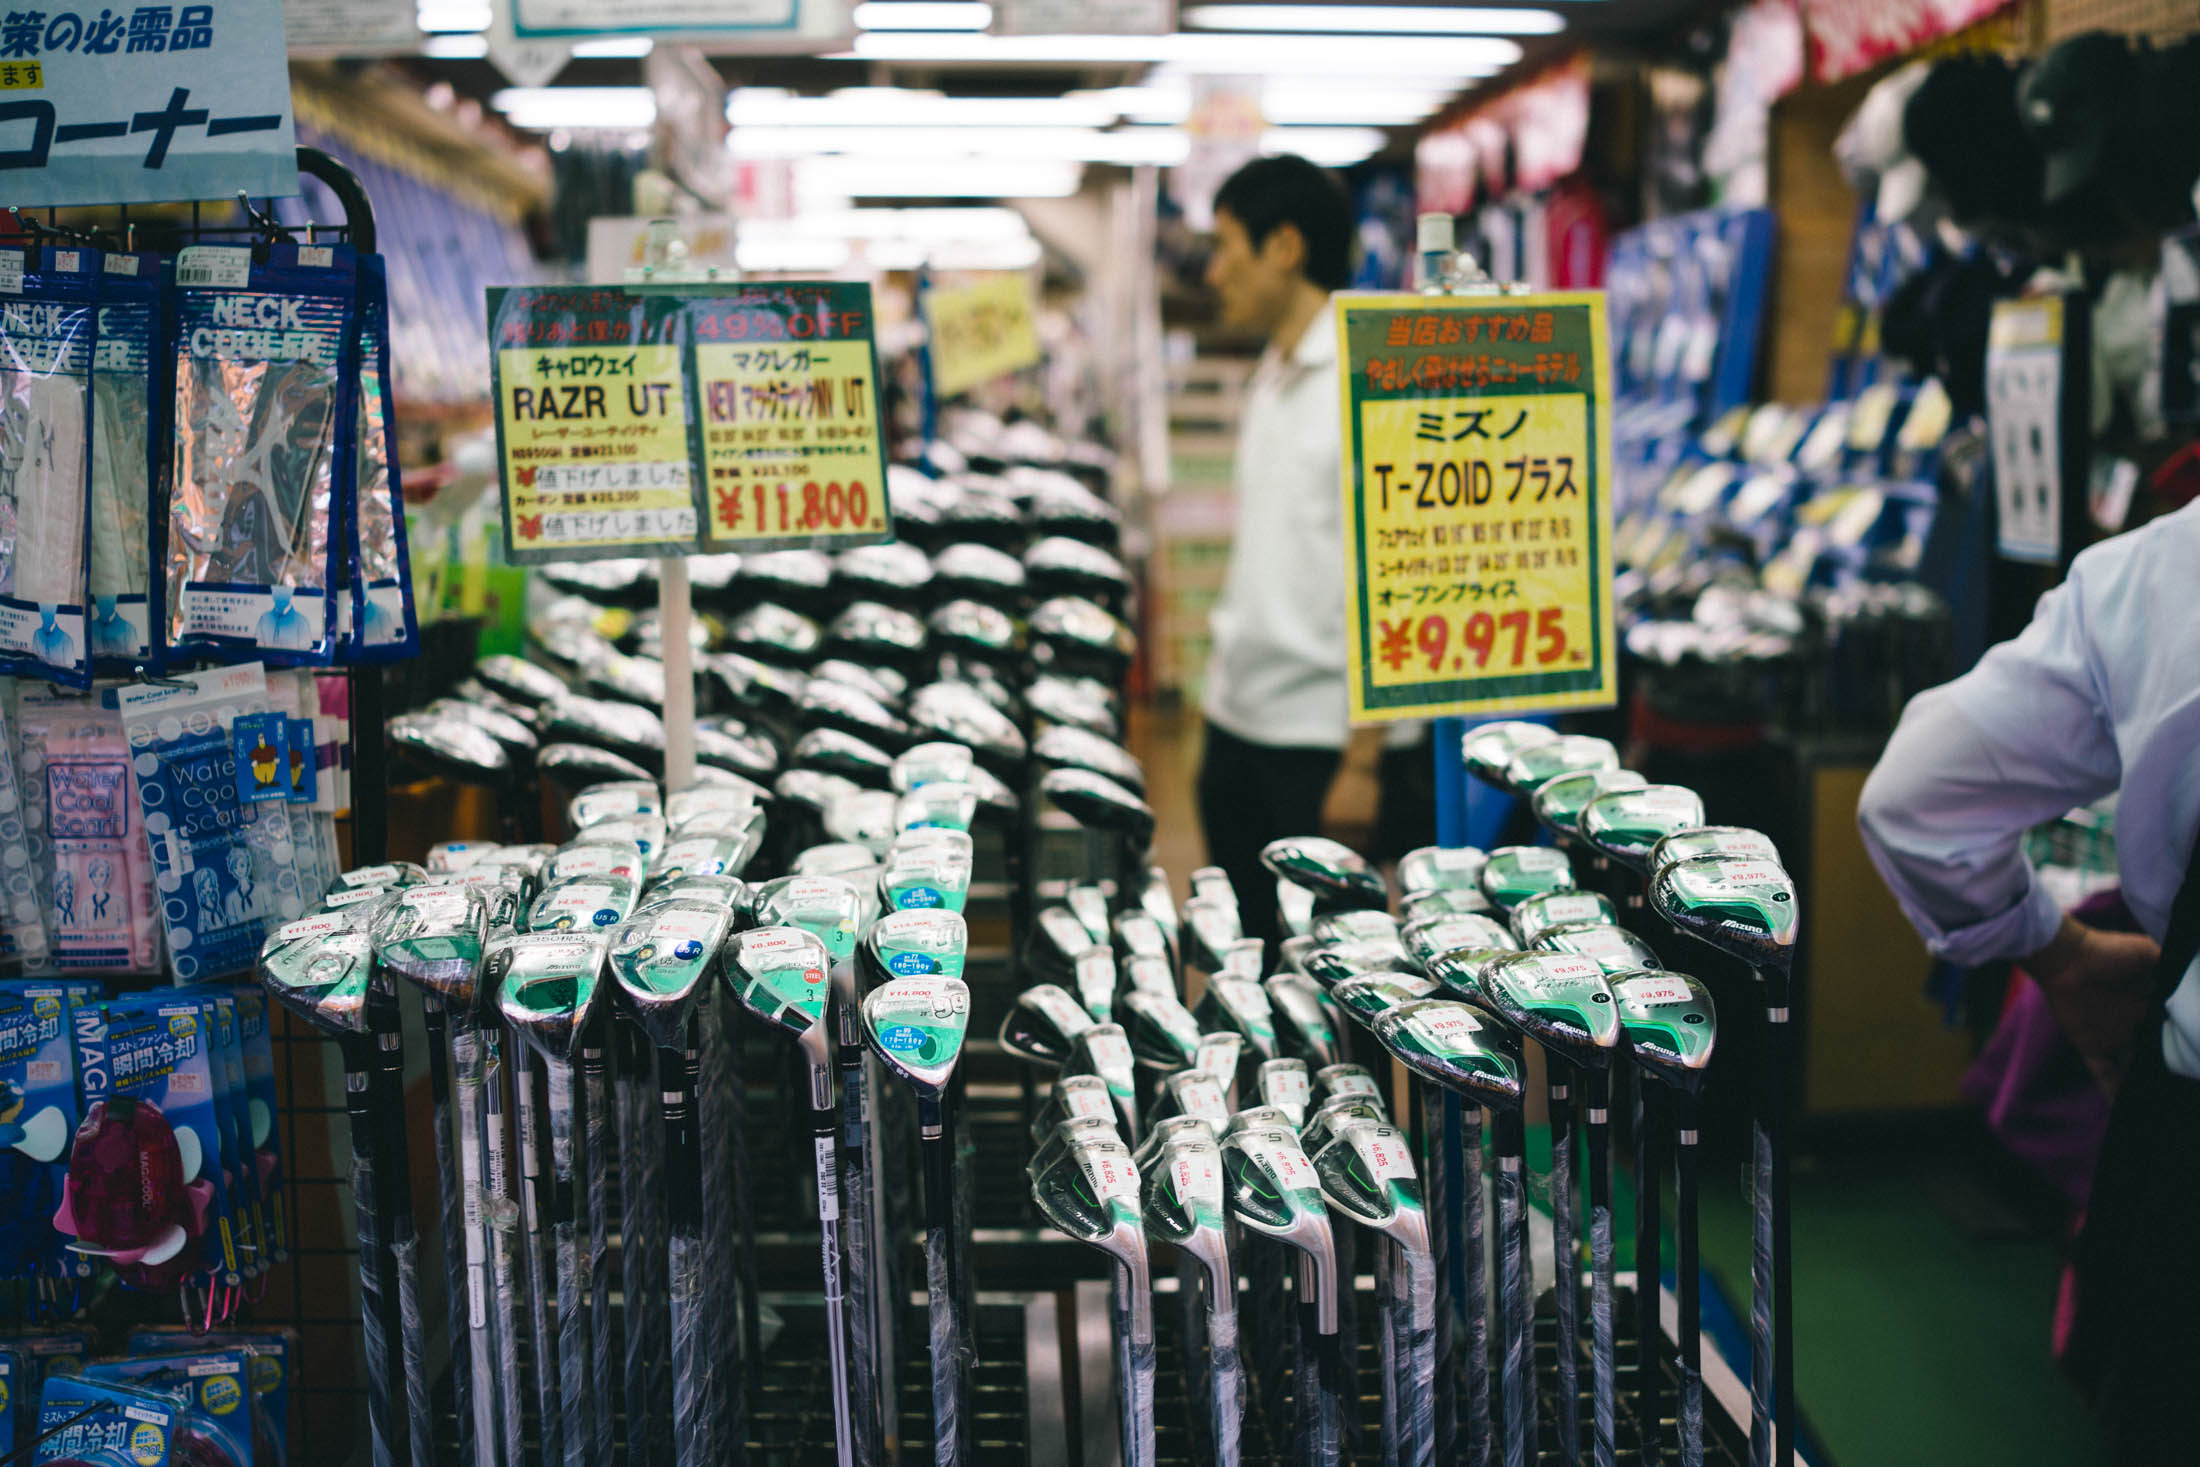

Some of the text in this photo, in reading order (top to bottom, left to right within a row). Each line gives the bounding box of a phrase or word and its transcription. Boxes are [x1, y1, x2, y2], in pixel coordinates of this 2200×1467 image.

[0, 5, 214, 58] 策の必需品
[2, 64, 41, 86] ます
[0, 87, 282, 170] コーナー
[2, 303, 63, 336] NECK
[213, 297, 304, 329] NECK
[696, 312, 863, 339] 49%OFF
[1386, 312, 1554, 347] 当店おすすめ品
[191, 327, 323, 361] COOLER
[537, 353, 637, 380] キャロウェイ
[732, 349, 830, 372] マクレガー
[512, 383, 672, 421] RAZR UT
[1416, 409, 1528, 442] ミズノ
[538, 466, 687, 490] 値下げしました
[1374, 454, 1578, 511] T-ZOID プラス
[545, 514, 696, 538] 値下げしました
[1377, 578, 1519, 607] オープンプライス
[50, 767, 123, 790] Water
[171, 758, 236, 785] Wate
[55, 789, 114, 813] Cool
[183, 784, 235, 808] Coo
[54, 813, 121, 834] Scarf
[836, 930, 844, 942] 3
[1721, 919, 1763, 934] Mizuno
[805, 972, 821, 980] STEEL
[806, 989, 815, 1002] 3
[1552, 1021, 1588, 1037] Mizuno
[112, 1035, 196, 1077] 瞬間冷却
[1641, 1041, 1676, 1057] Mizuno
[1472, 1069, 1506, 1083] Mizuno
[1377, 1127, 1392, 1137] 5
